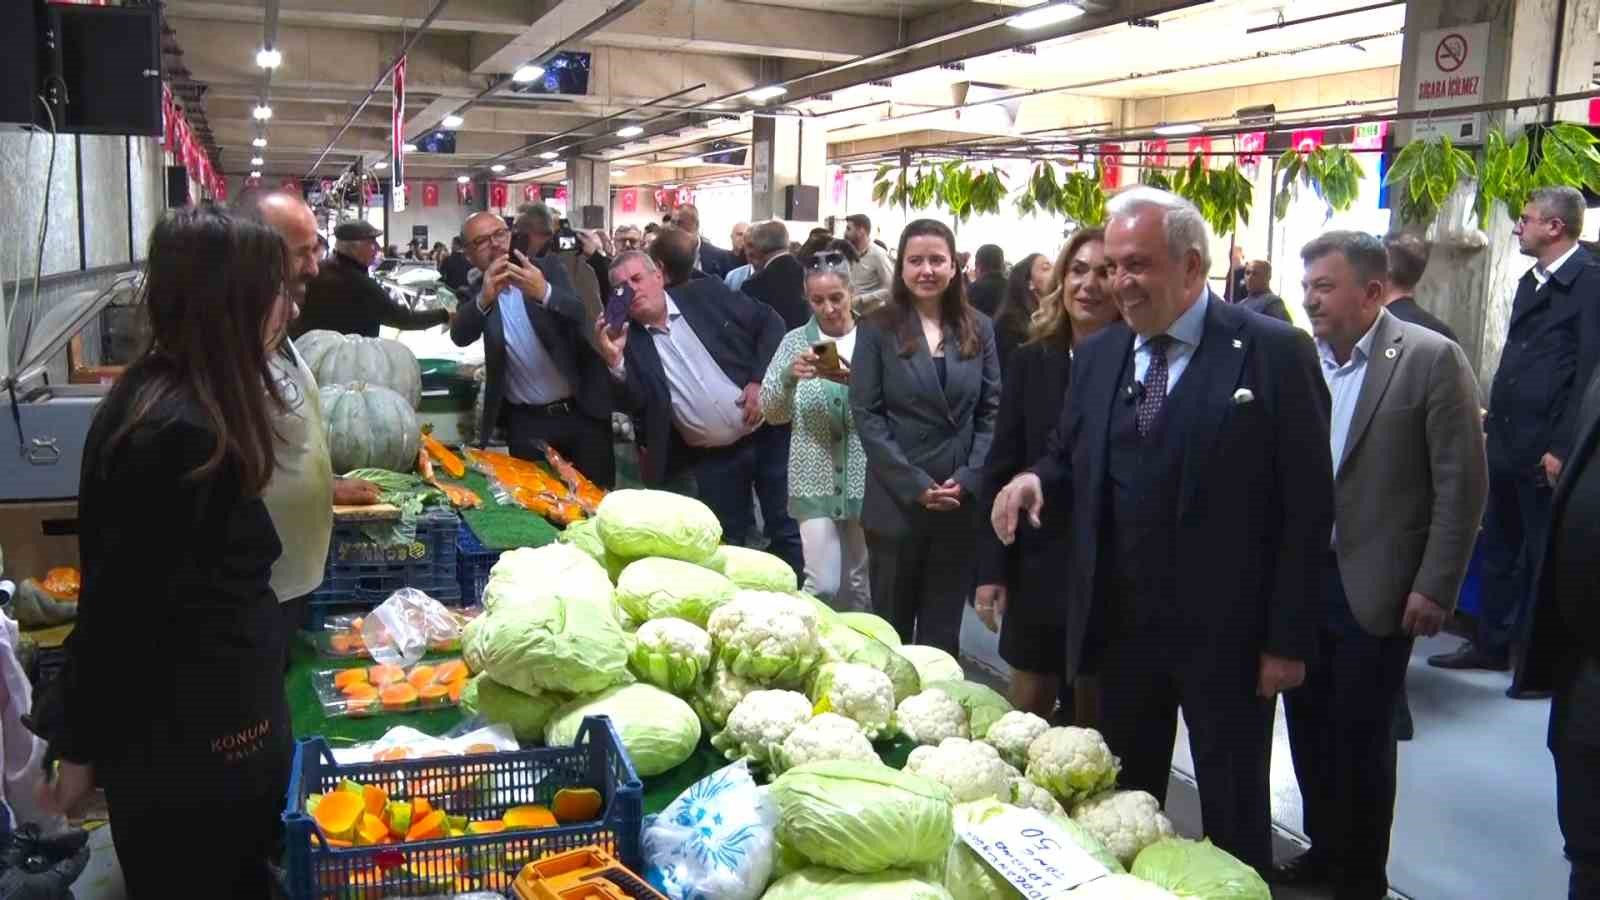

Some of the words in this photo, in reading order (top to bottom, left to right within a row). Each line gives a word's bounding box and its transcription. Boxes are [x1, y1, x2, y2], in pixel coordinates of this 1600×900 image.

[1448, 76, 1480, 100] İÇİLMEZ
[210, 719, 270, 753] KONUM
[1020, 828, 1062, 851] 50
